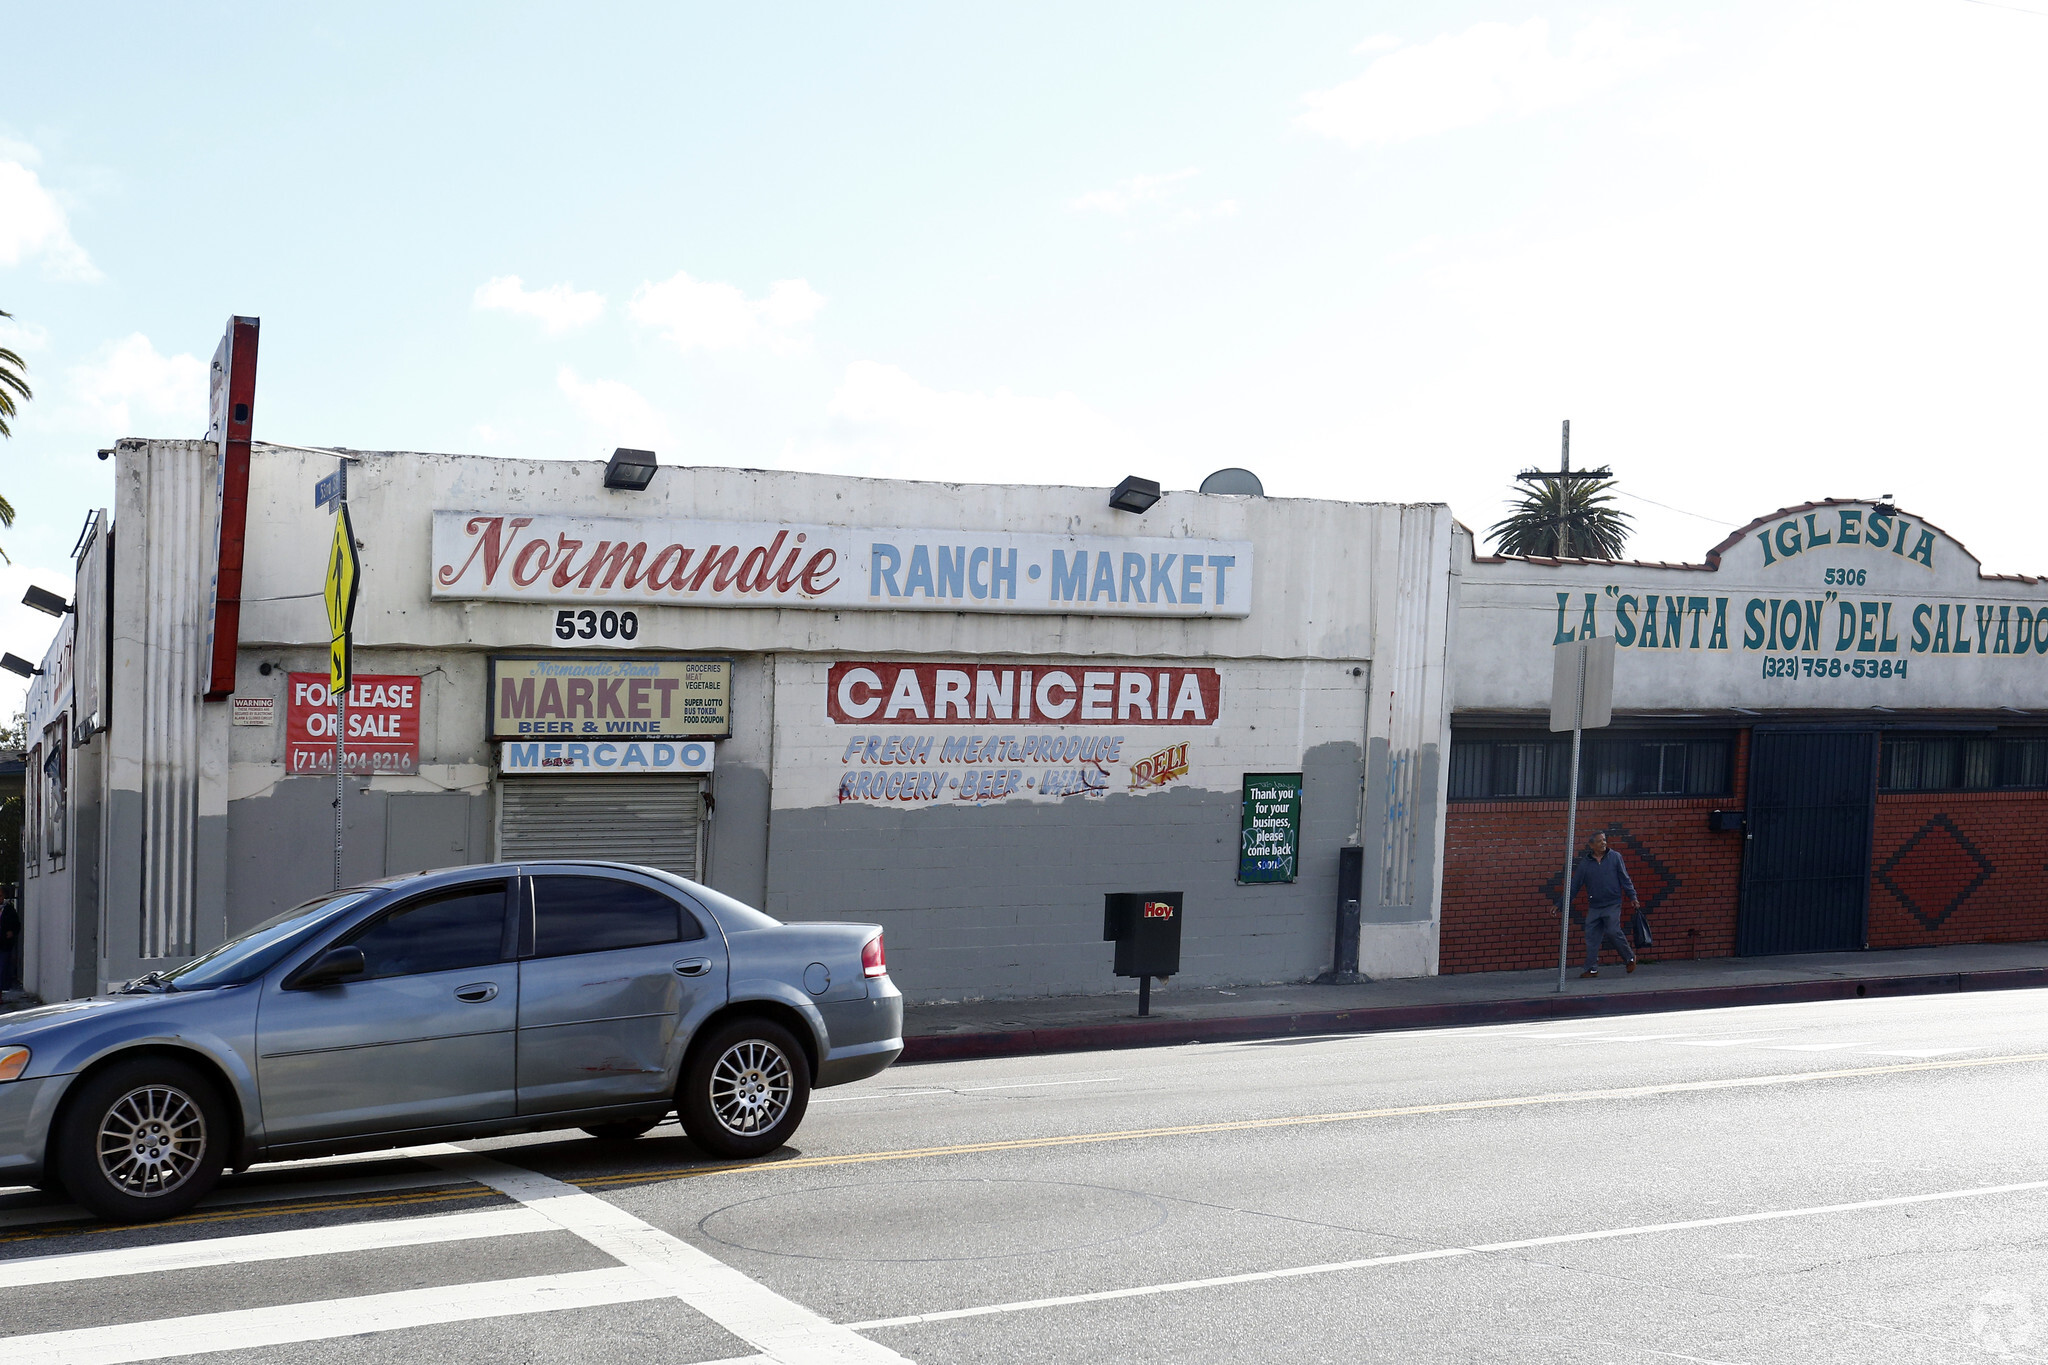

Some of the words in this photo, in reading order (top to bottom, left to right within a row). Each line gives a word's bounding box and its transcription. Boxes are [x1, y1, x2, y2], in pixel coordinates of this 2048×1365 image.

[1757, 511, 1936, 568] IGLESIA
[438, 516, 841, 596] Normandie
[869, 543, 1018, 600] RANCH
[1050, 549, 1236, 605] MARKET
[1824, 568, 1867, 586] 5306
[555, 610, 639, 640] 5300
[1553, 593, 1597, 645] LA
[1835, 601, 1898, 653] DEL
[530, 661, 615, 677] Normandie
[615, 662, 660, 677] Ranch
[686, 664, 721, 672] GROCERIES
[685, 681, 721, 690] VEGETABLE
[837, 667, 1207, 720] CARNICERIA
[235, 699, 273, 707] WARNING
[348, 684, 413, 708] LEASE
[501, 677, 680, 719] MARKET
[684, 698, 703, 706] SUPER
[704, 698, 723, 706] LOTTO
[684, 707, 696, 715] BUS
[697, 707, 717, 715] TOKEN
[306, 713, 338, 736] OR
[348, 714, 401, 737] SALE
[518, 721, 574, 733] BEER
[581, 721, 598, 733] &
[606, 721, 661, 733] WINE
[510, 743, 706, 767] MERCADO
[842, 735, 935, 765] FRESH
[293, 748, 333, 771] (714)
[1136, 744, 1188, 786] DELI
[839, 770, 949, 801] GROCERY
[960, 770, 1022, 800] BEER
[1250, 788, 1276, 800] Thank
[1278, 789, 1294, 801] you
[1255, 802, 1268, 814] for
[1270, 804, 1289, 816] your
[1252, 816, 1290, 828] business,
[1256, 830, 1283, 844] please
[1247, 845, 1270, 856] come
[1271, 843, 1292, 855] back
[1144, 902, 1174, 920] Hoy
